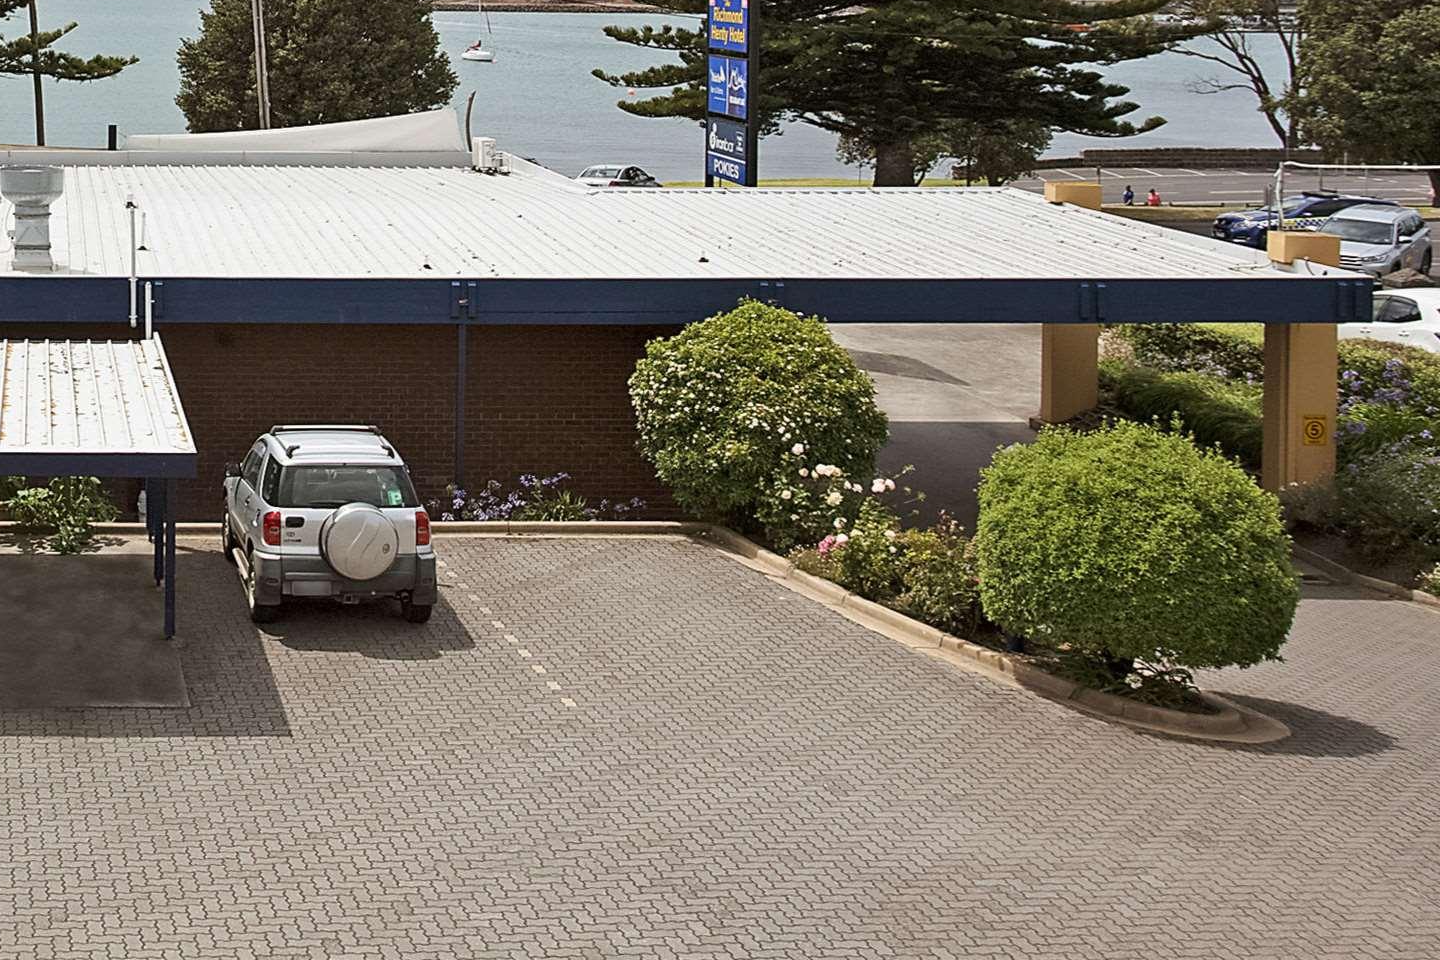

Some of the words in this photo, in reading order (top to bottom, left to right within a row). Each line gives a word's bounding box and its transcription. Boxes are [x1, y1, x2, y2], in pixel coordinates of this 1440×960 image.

[713, 7, 743, 24] Richmond
[711, 24, 729, 46] Henty
[729, 26, 745, 43] Hotel
[713, 158, 740, 179] POKIES
[1310, 424, 1319, 436] 5
